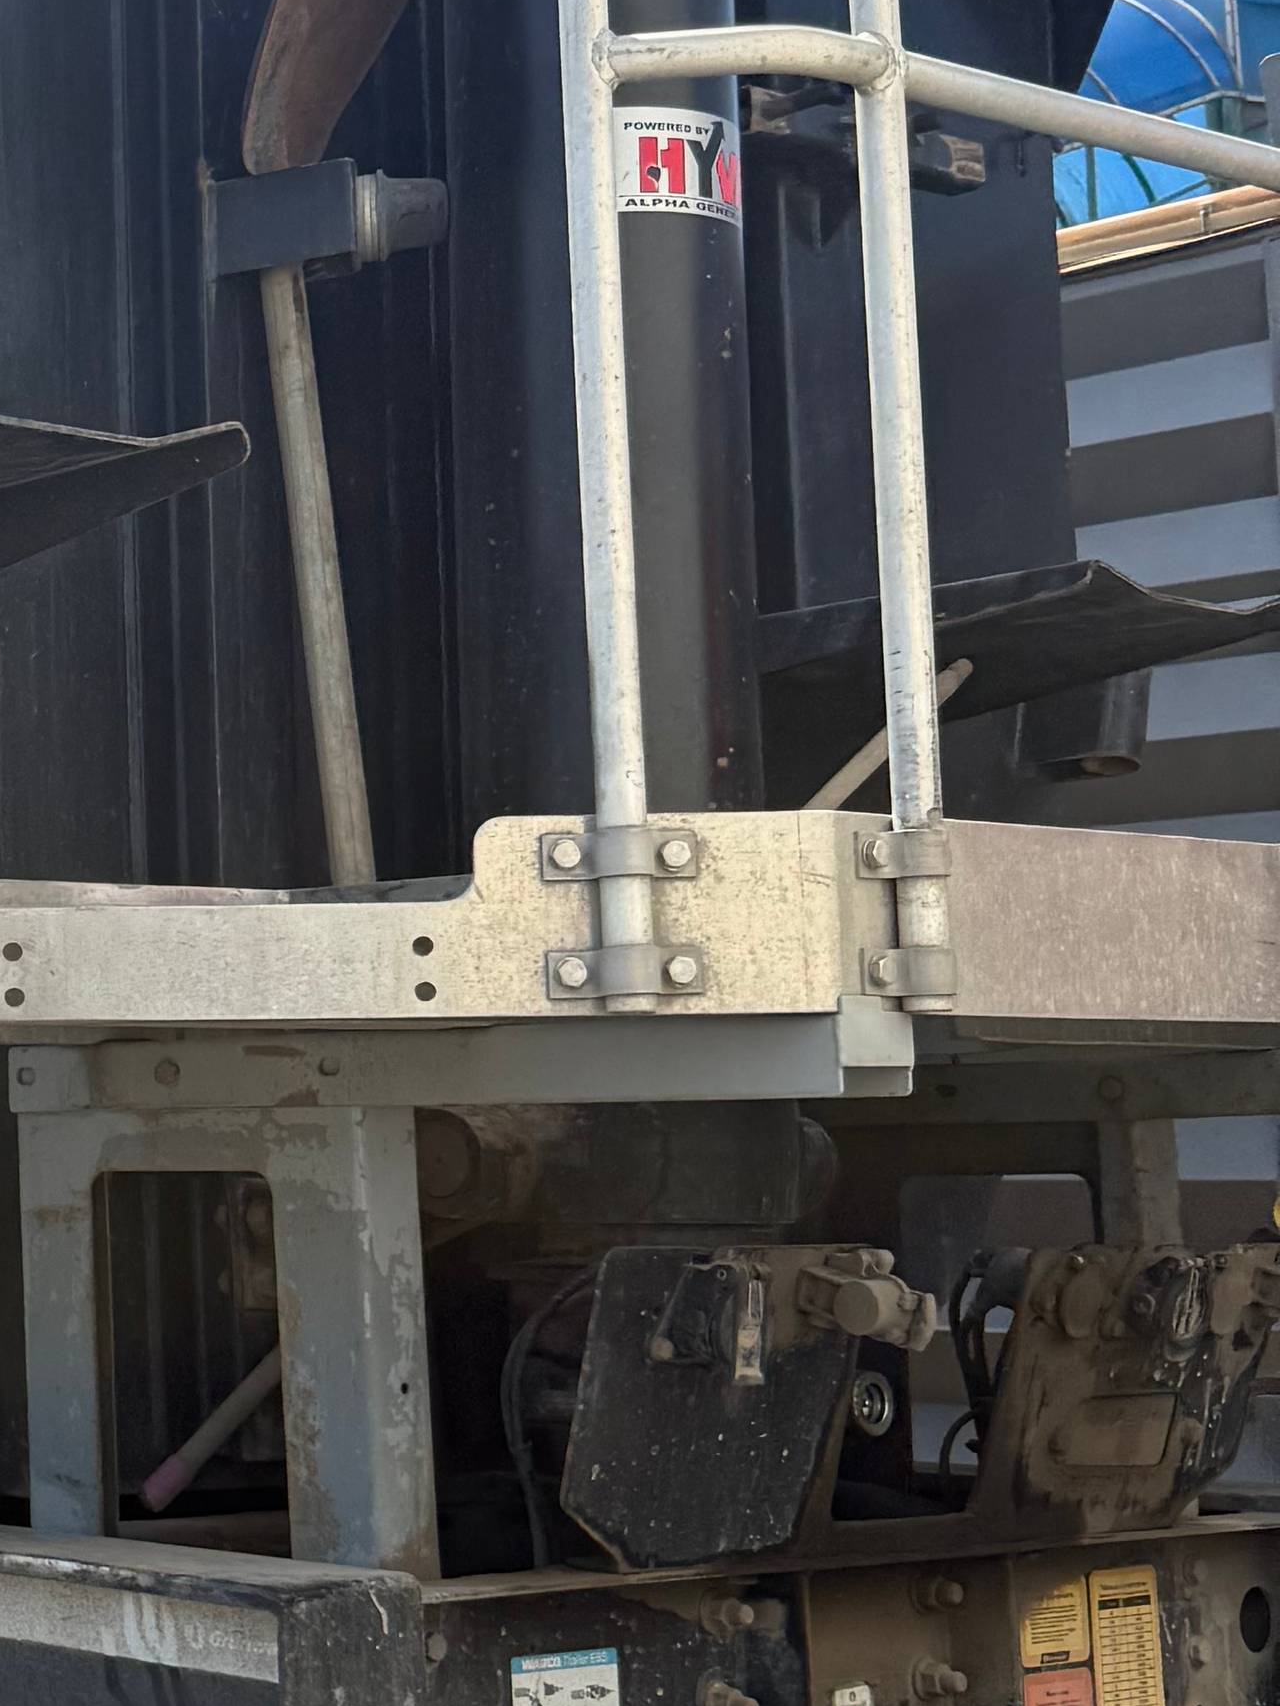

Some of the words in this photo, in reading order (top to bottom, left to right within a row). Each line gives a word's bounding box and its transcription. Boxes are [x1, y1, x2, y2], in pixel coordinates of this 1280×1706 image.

[623, 122, 692, 133] POWERED
[695, 126, 711, 136] BY
[625, 198, 690, 209] ALPHA
